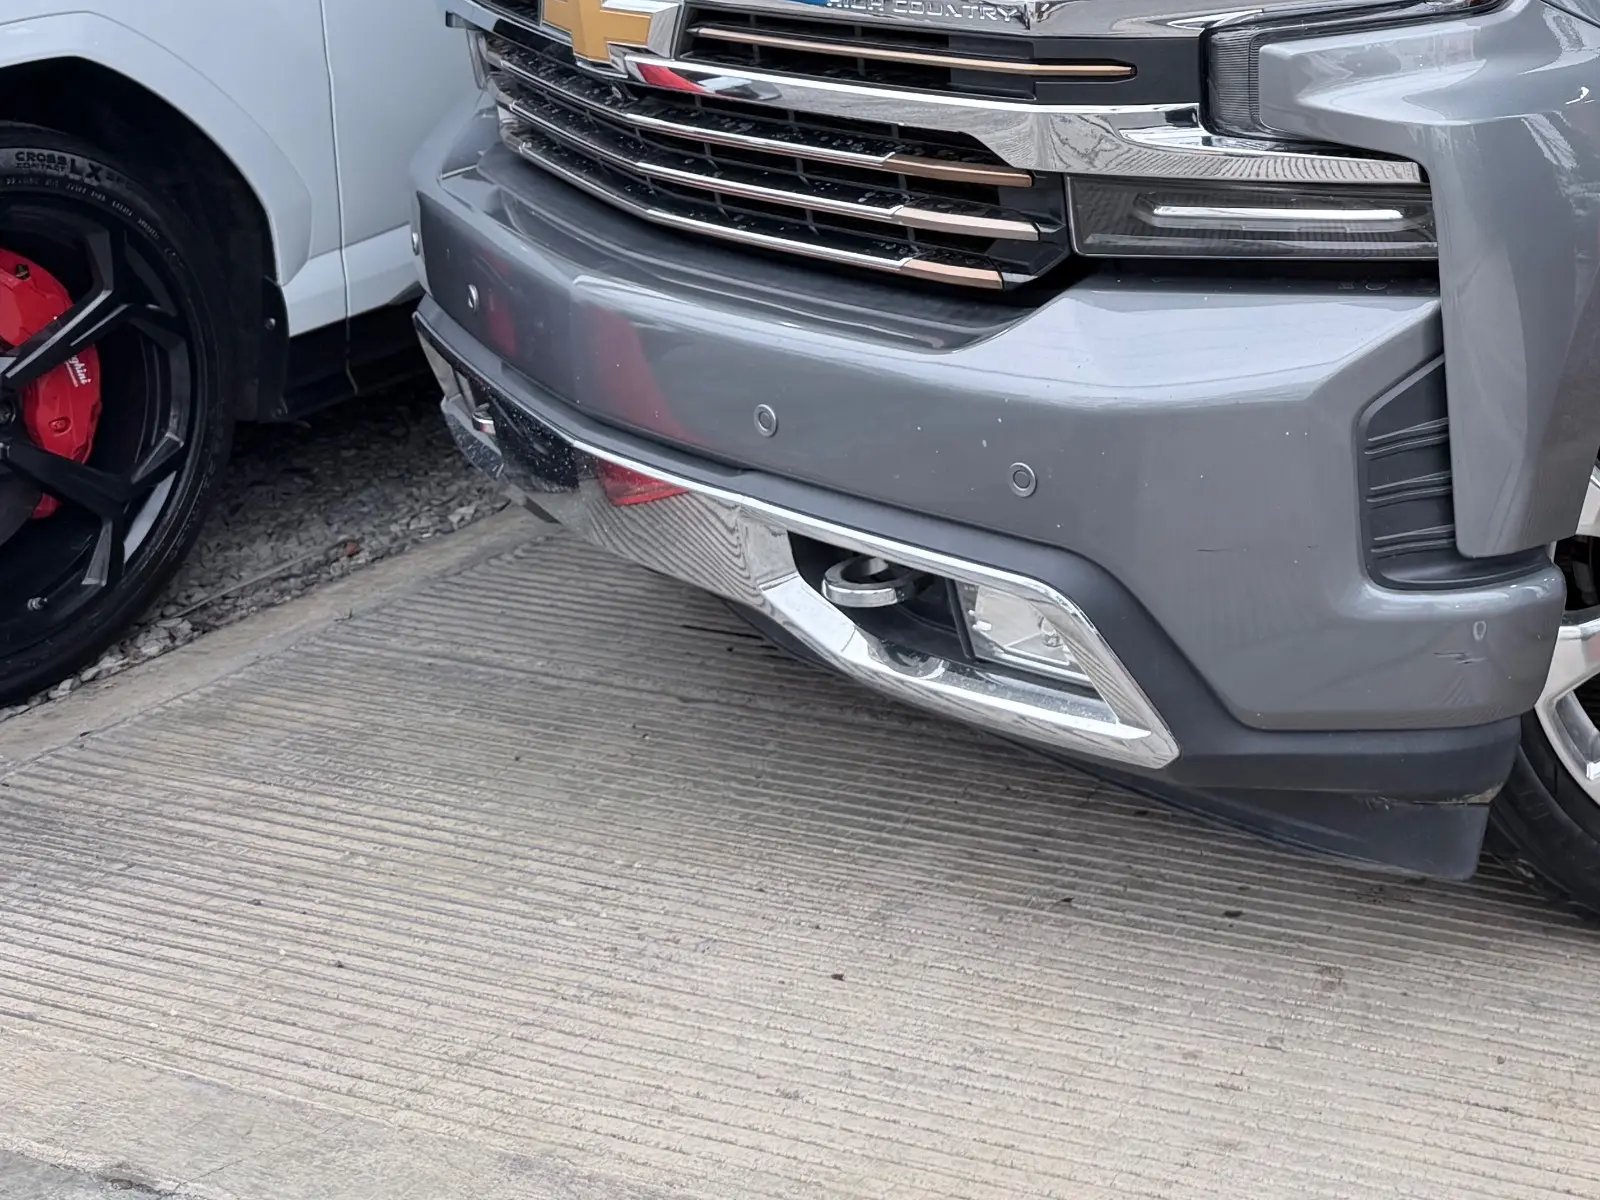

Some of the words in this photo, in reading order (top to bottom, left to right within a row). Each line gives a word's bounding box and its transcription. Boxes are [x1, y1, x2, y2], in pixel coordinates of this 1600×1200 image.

[893, 0, 1019, 22] COUNTRY
[15, 151, 67, 166] CROSS
[69, 158, 102, 184] LX
